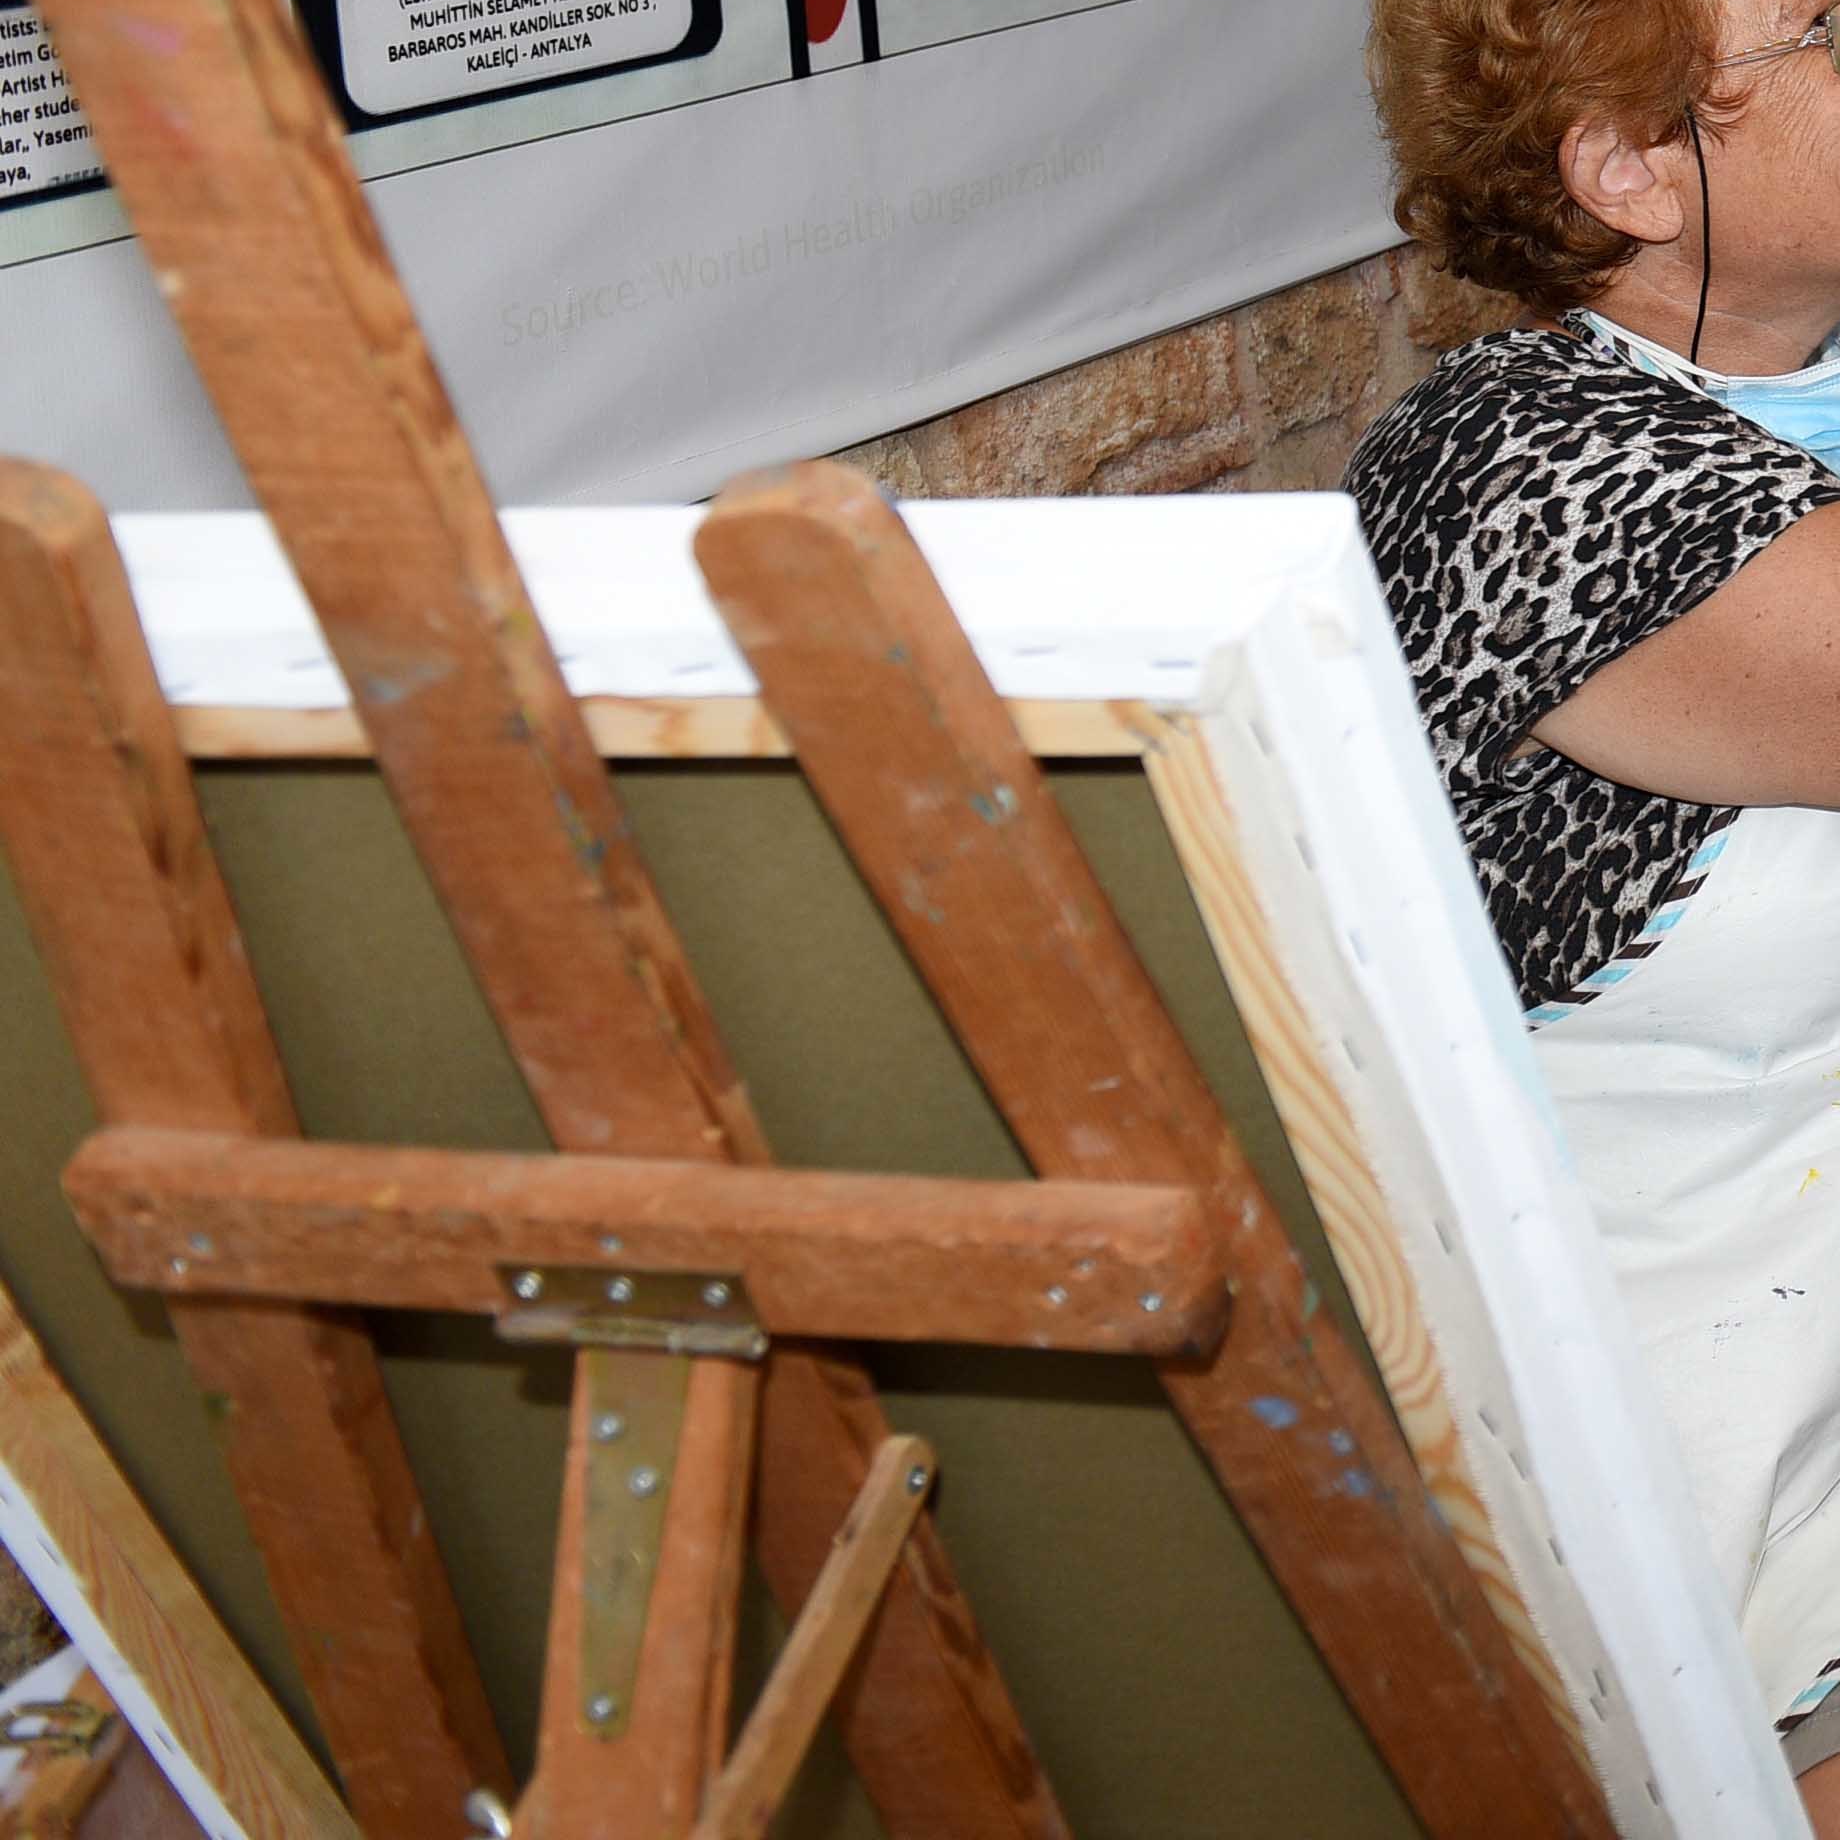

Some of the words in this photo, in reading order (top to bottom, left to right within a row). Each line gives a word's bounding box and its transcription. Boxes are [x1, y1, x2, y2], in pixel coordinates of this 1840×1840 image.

[409, 0, 484, 30] MUHİTTİN
[0, 20, 38, 40] tists:
[387, 29, 467, 62] BARBAROS
[468, 22, 507, 45] MAH.
[508, 6, 584, 37] KANDİLLER
[0, 49, 33, 69] etim
[466, 43, 519, 73] KALEİÇİ
[529, 31, 592, 60] ANTALYA
[1, 73, 47, 97] Artist
[34, 94, 80, 120] stude
[33, 122, 94, 147] Yasemi
[0, 165, 31, 187] aya,
[500, 278, 649, 350] Source:
[655, 235, 773, 302] World
[781, 199, 896, 267] Health
[908, 137, 1106, 227] Organization
